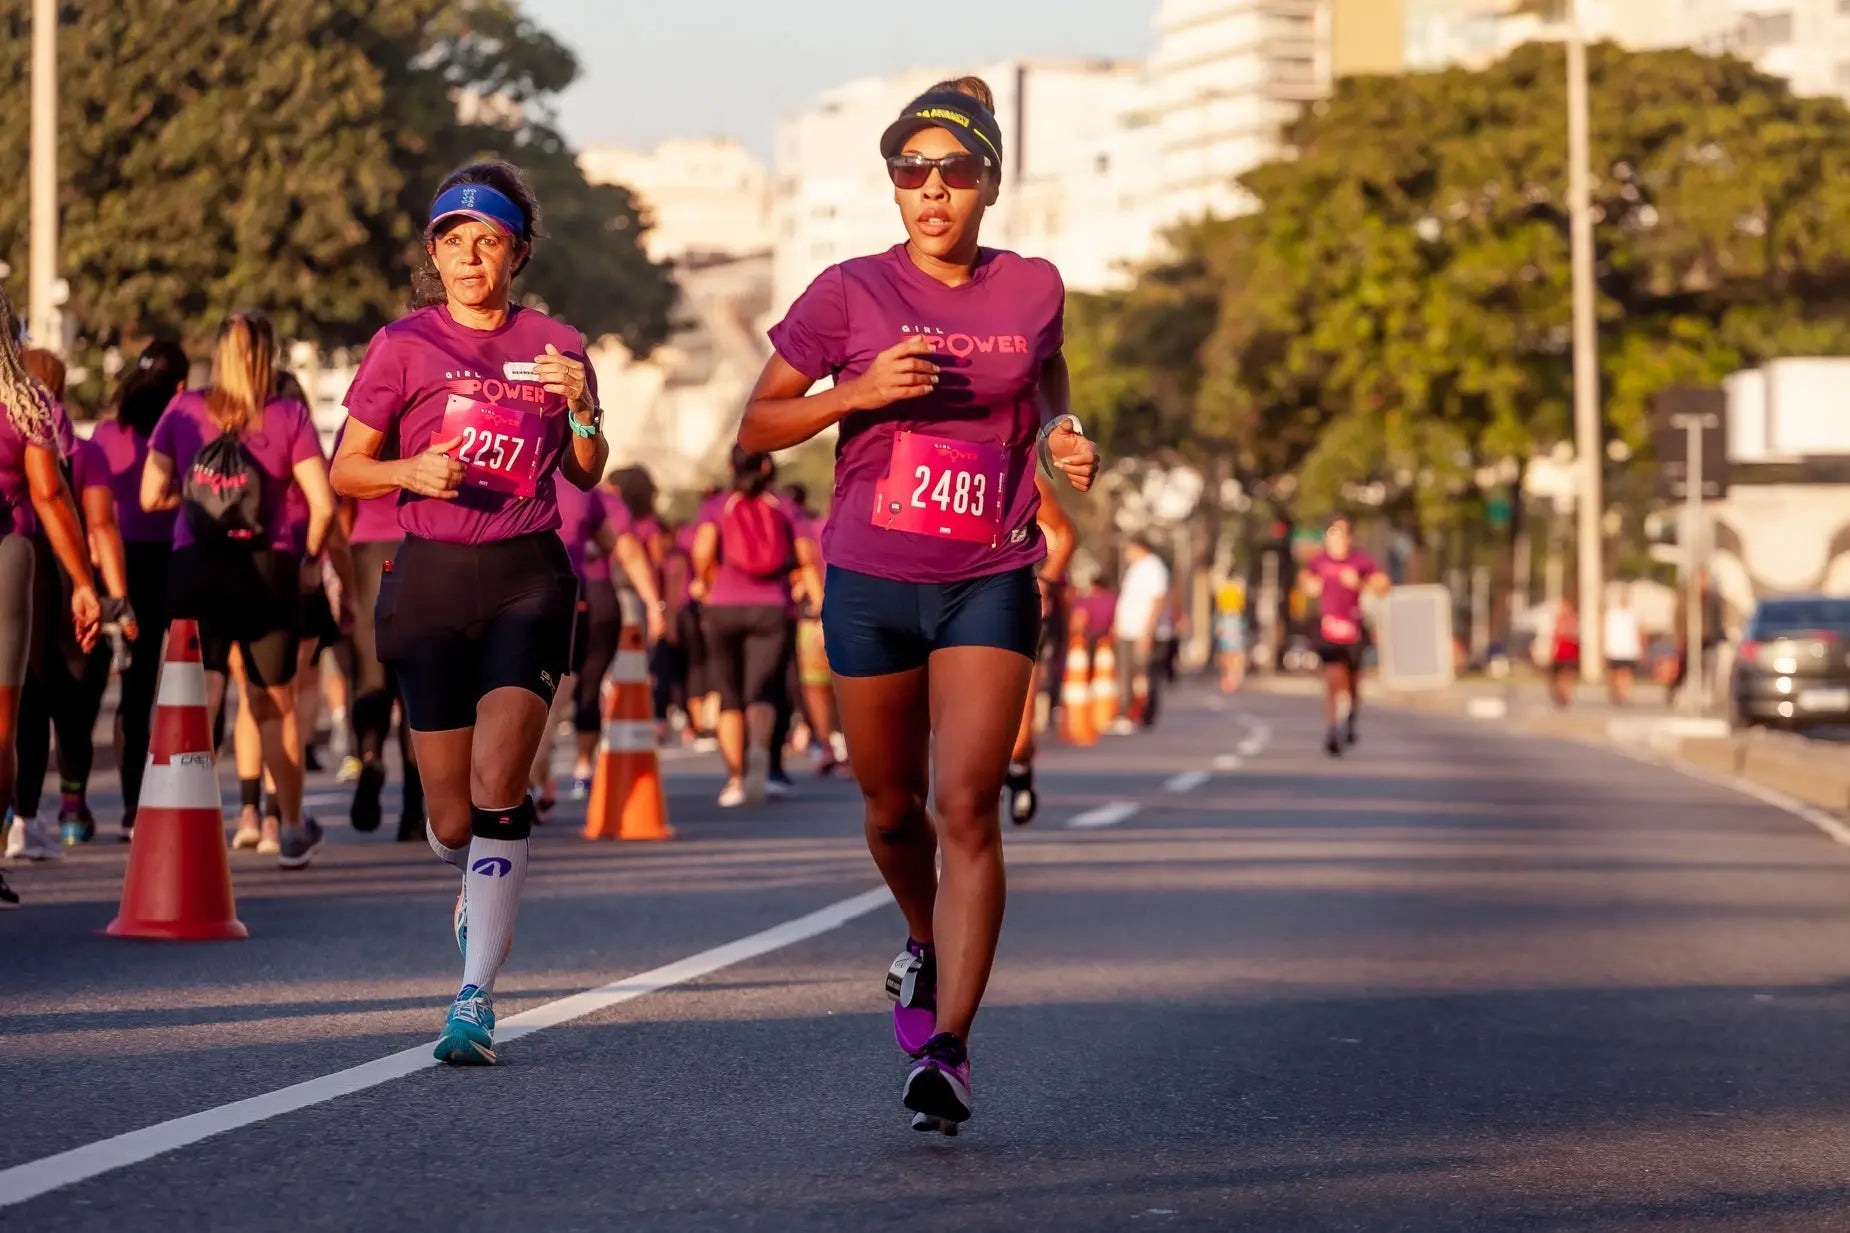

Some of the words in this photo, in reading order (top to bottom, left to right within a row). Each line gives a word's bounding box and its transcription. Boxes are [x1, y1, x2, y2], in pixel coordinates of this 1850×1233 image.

[901, 324, 944, 334] GIRL
[445, 369, 481, 379] GIRL
[452, 379, 545, 405] POWER
[459, 426, 525, 472] 2257
[911, 465, 986, 517] 2483
